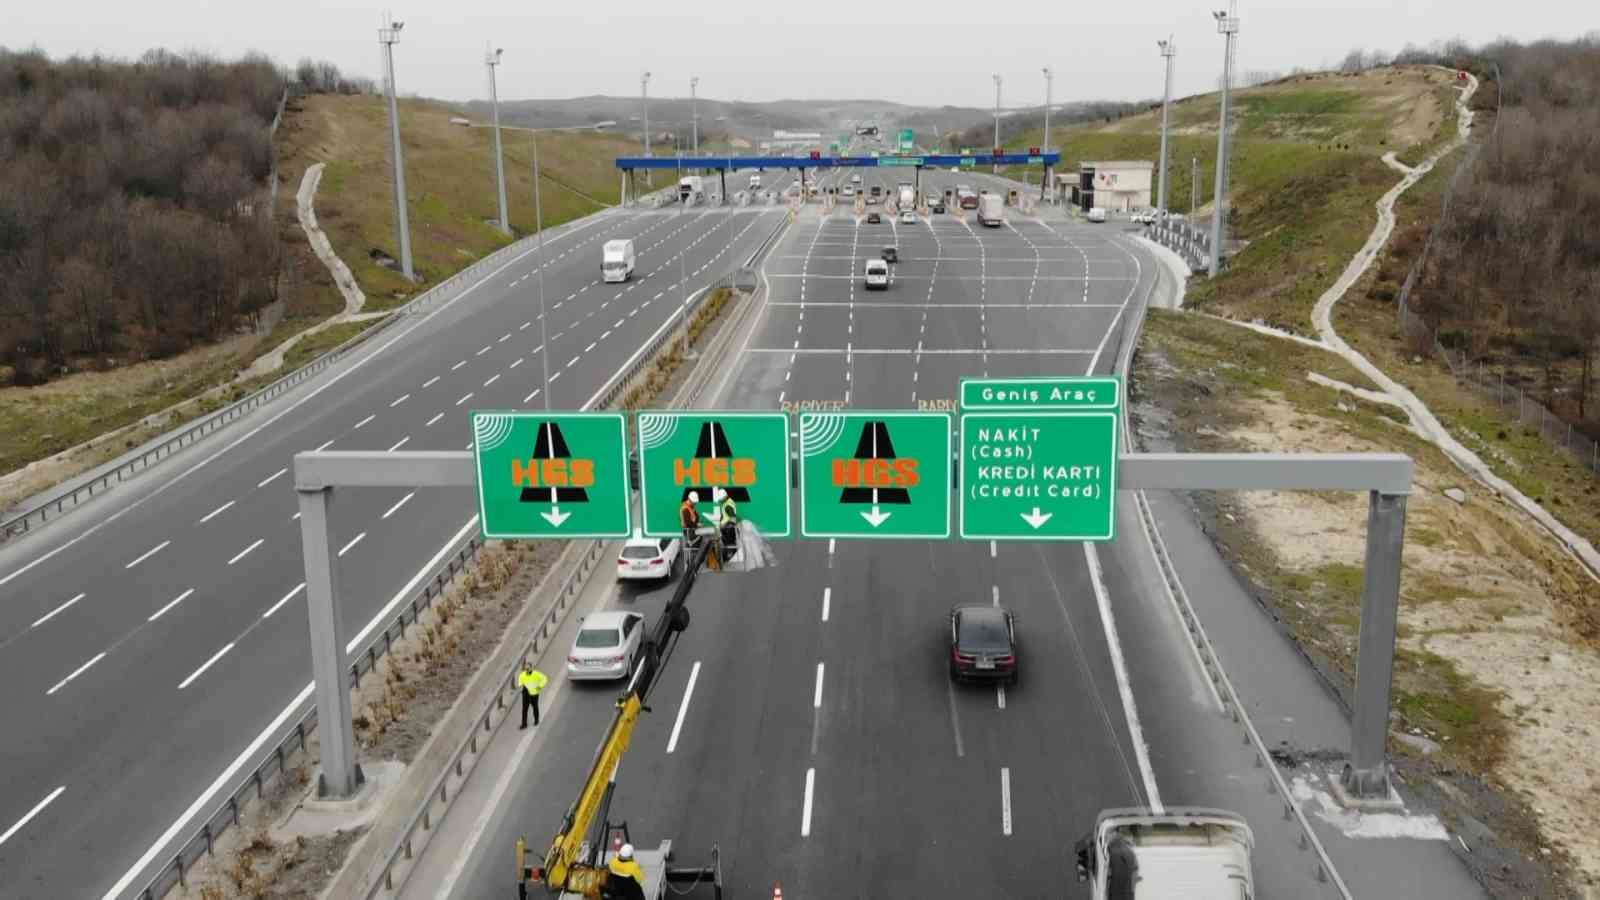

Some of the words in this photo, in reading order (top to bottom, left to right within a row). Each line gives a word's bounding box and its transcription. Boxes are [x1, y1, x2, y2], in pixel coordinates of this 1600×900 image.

[982, 388, 1039, 402] Geniş
[1050, 387, 1096, 402] Araç
[979, 426, 1040, 442] NAKİT
[972, 445, 1033, 460] (Cash)
[512, 459, 594, 487] HGS
[675, 459, 756, 486] HGS
[833, 459, 919, 486] HGS
[978, 464, 1036, 480] KREDİ
[1043, 466, 1101, 480] KARTI
[971, 484, 1040, 500] (Credit
[1047, 484, 1101, 500] Card)
